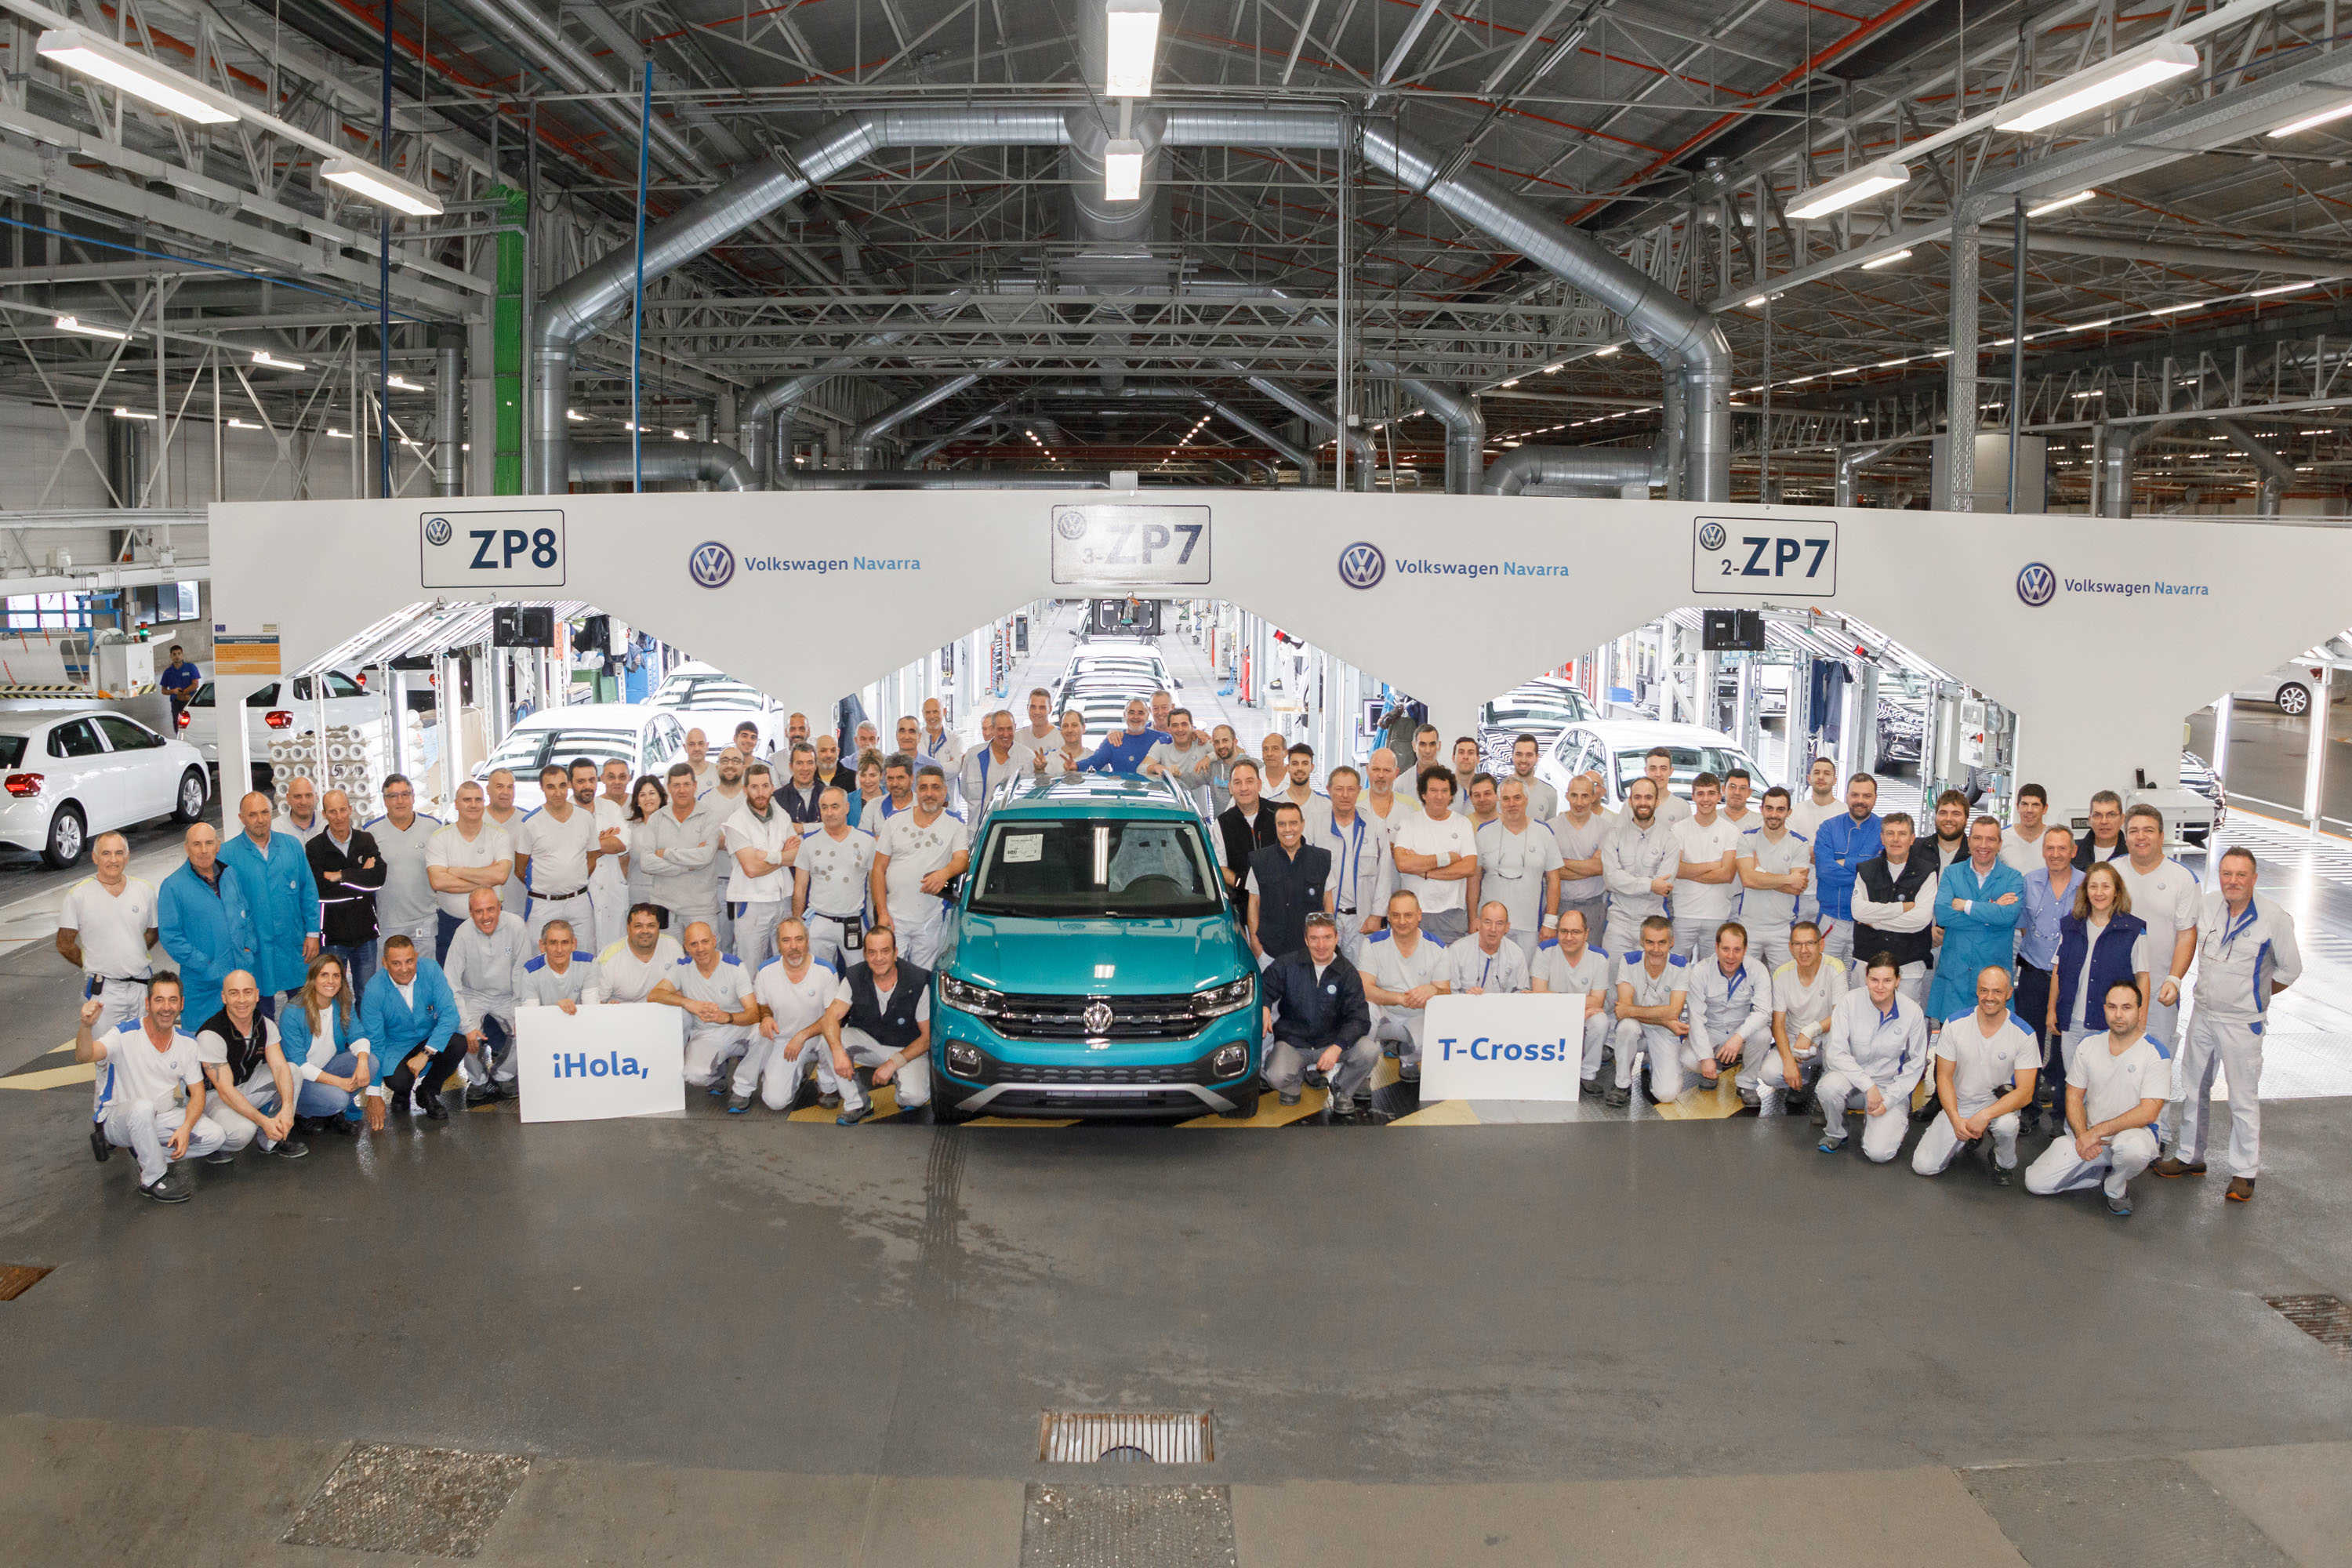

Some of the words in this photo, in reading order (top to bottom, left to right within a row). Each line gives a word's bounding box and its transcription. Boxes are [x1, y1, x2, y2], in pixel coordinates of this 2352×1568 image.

[469, 528, 557, 569] ZP8
[1721, 536, 1831, 578] 2-ZP7
[744, 556, 848, 575] Volkswagen
[853, 556, 921, 571] Navarra
[1396, 559, 1499, 579] Volkswagen
[1503, 561, 1570, 577] Navarra
[2064, 579, 2151, 597] Volkswagen
[2154, 581, 2209, 596] Navarra
[1438, 1037, 1566, 1062] T-Cross!
[553, 1051, 649, 1080] ¡Hola,
